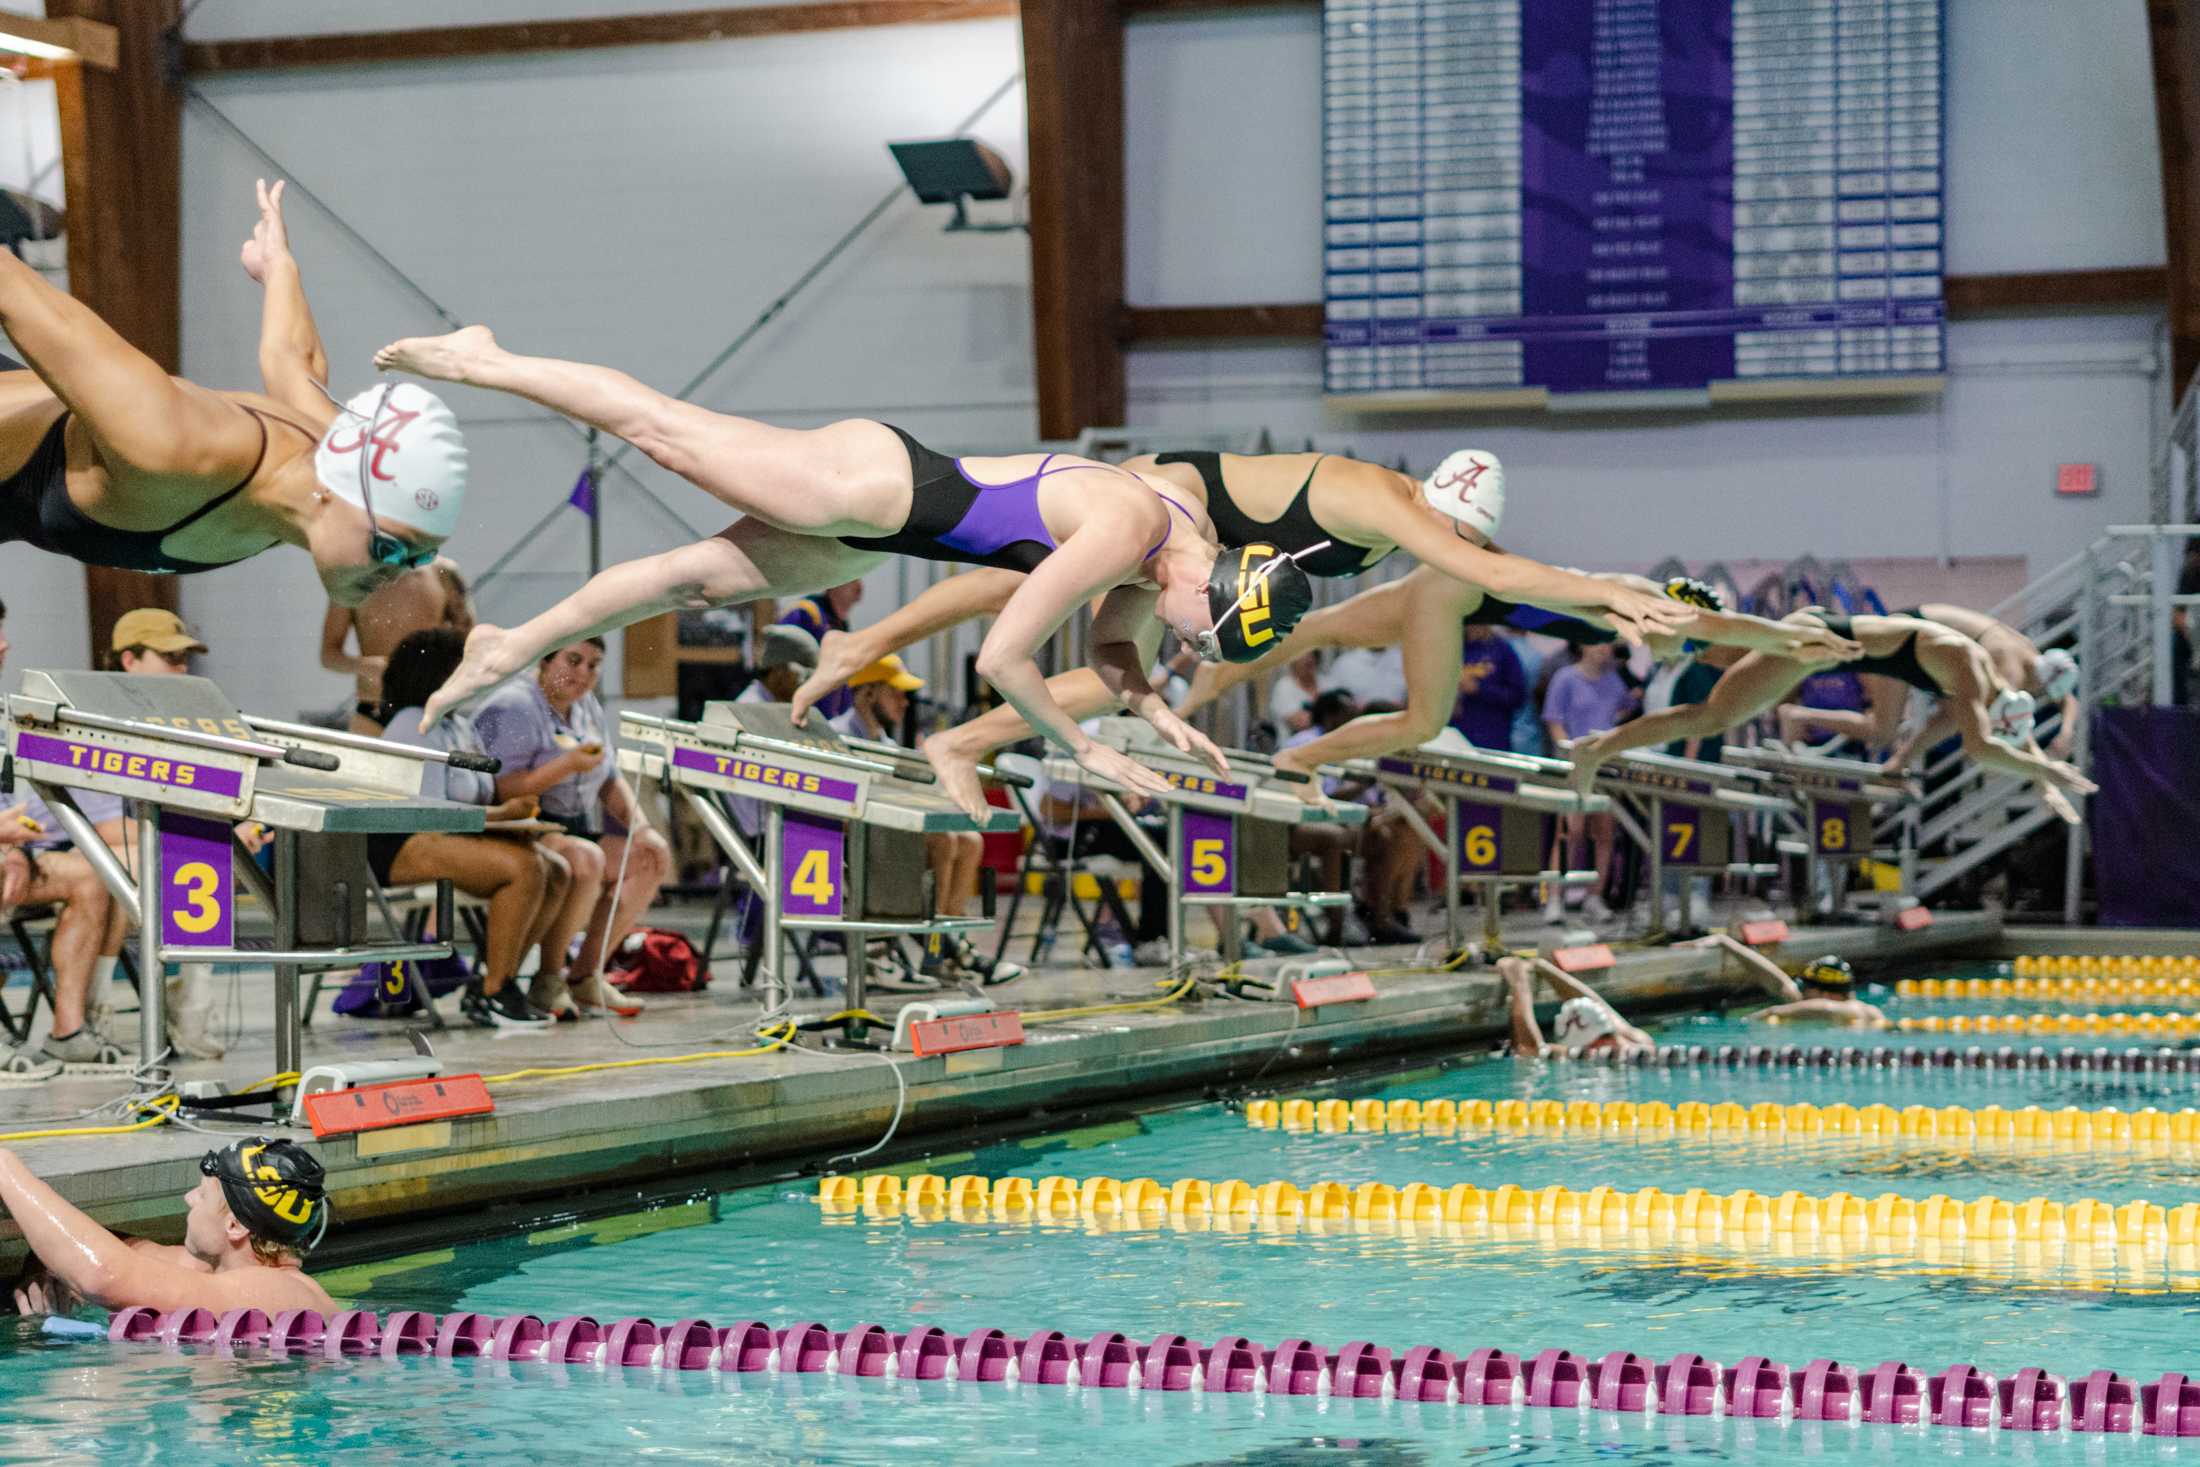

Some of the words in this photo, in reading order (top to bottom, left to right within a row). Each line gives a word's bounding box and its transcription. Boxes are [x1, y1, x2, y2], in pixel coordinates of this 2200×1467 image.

[68, 745, 196, 785] TIGERS
[715, 757, 821, 793] TIGERS
[1464, 825, 1497, 865] 6
[1667, 823, 1695, 858] 7
[1822, 817, 1847, 849] 8
[790, 849, 834, 905] 4
[1190, 838, 1227, 886] 5
[172, 861, 222, 933] 3
[385, 960, 405, 996] 3
